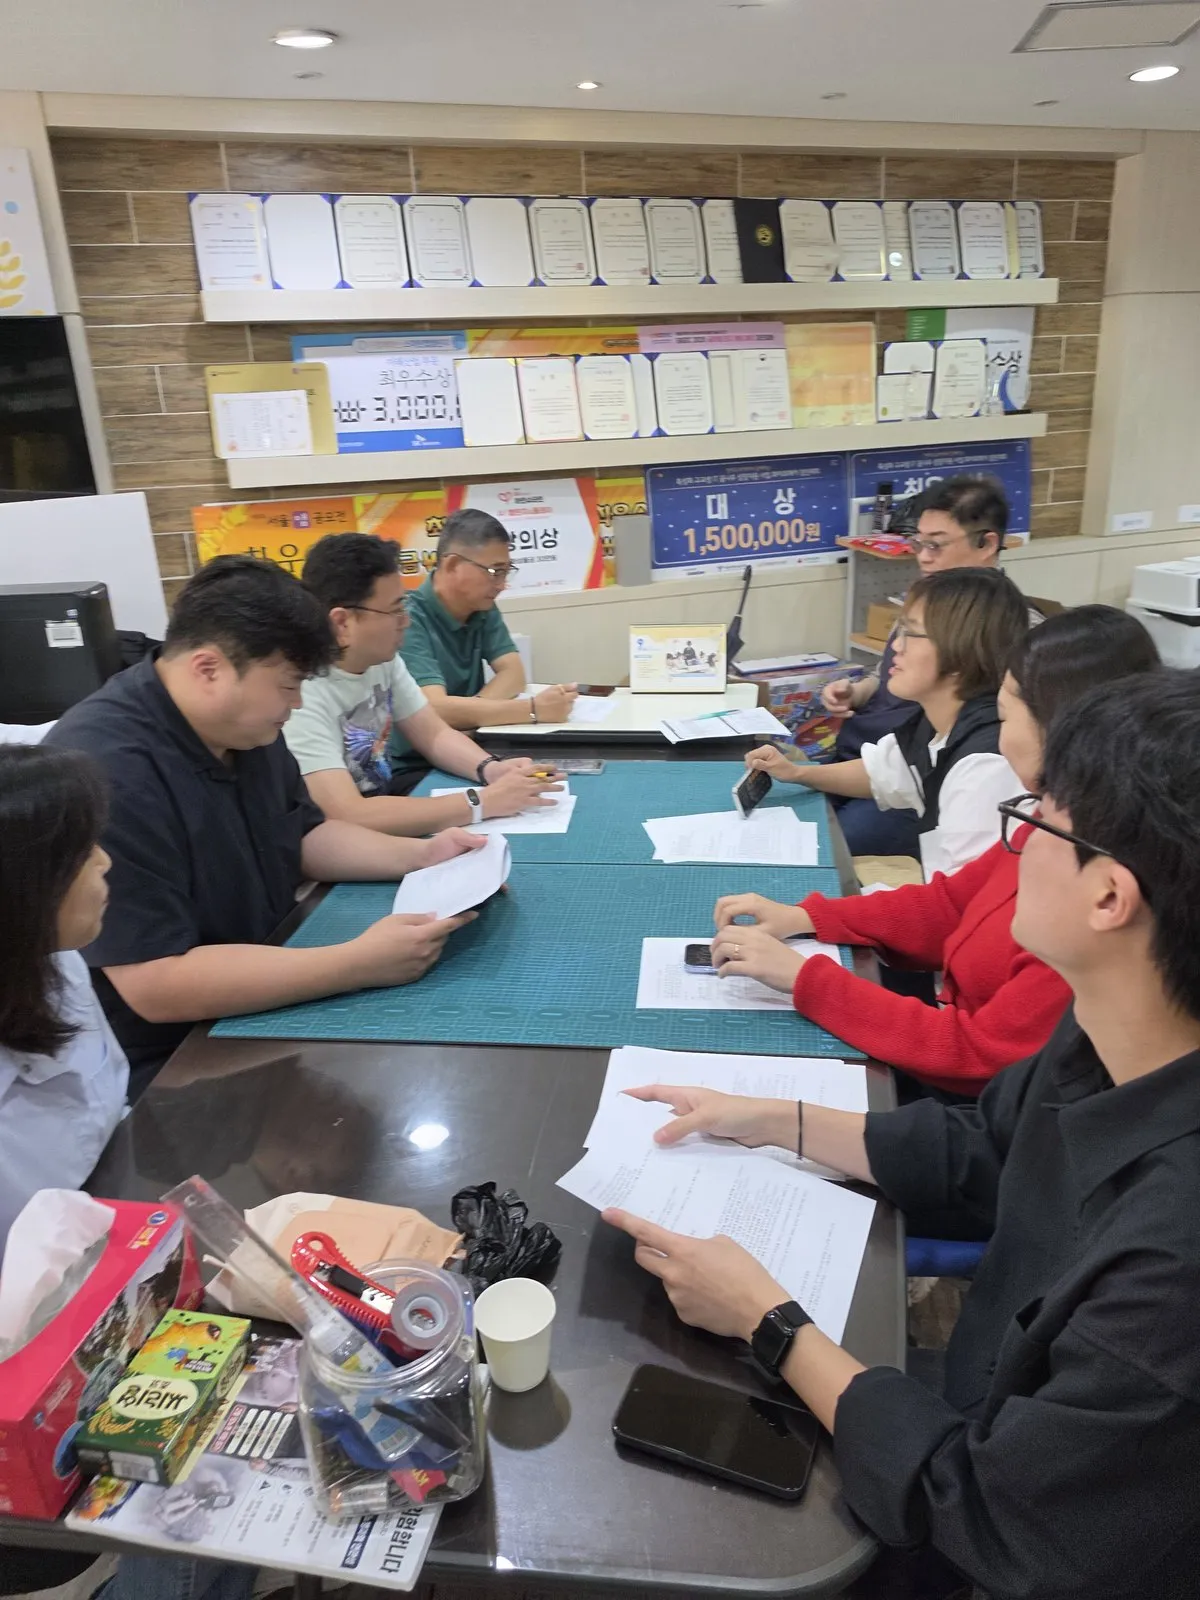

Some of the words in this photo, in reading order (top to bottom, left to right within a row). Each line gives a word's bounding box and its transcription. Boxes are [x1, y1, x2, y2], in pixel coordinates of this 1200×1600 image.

[985, 350, 1022, 374] 수상
[379, 369, 453, 389] 최우수상
[683, 518, 821, 556] 1,500,000원
[116, 1384, 189, 1411] 씨리얼
